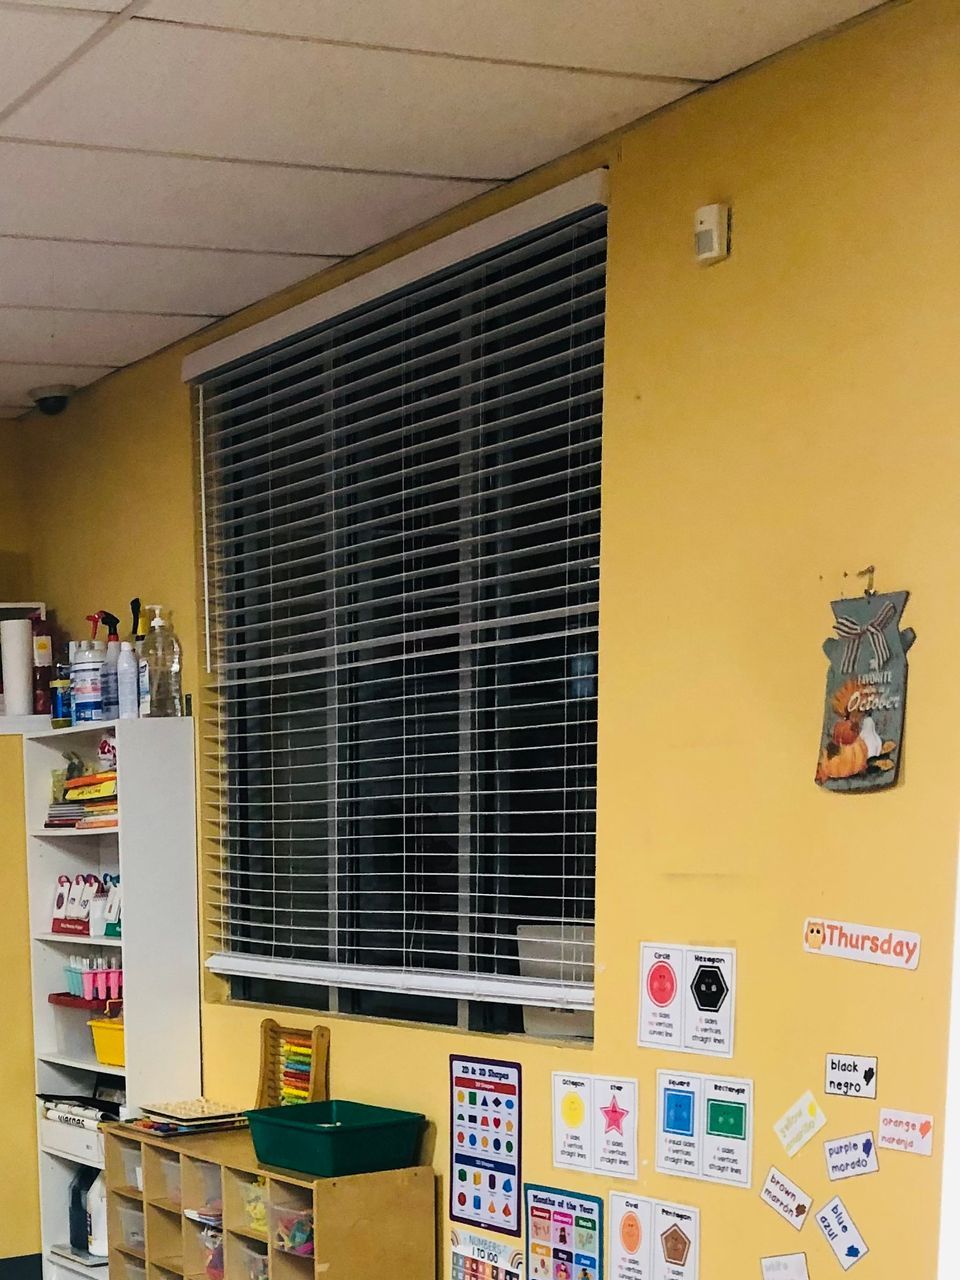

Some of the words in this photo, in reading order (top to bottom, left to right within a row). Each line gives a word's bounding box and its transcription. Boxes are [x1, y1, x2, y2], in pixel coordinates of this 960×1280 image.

[848, 691, 900, 712] October
[826, 924, 918, 964] Thursday
[654, 952, 671, 960] Circle
[694, 954, 726, 964] Hexagon
[831, 1059, 858, 1073] black
[488, 1069, 510, 1080] Shapes
[562, 1079, 586, 1088] Octagon
[668, 1079, 690, 1088] Square
[714, 1084, 746, 1095] Rectangle
[829, 1080, 862, 1096] negro
[882, 1118, 917, 1132] orange
[828, 1142, 859, 1158] purple
[881, 1135, 914, 1149] naranja
[831, 1158, 868, 1174] morado
[770, 1174, 797, 1202] brown
[532, 1194, 556, 1206] Months
[558, 1200, 564, 1208] of
[566, 1202, 576, 1211] the
[579, 1204, 594, 1214] Year
[624, 1201, 638, 1210] Oval
[764, 1188, 794, 1218] marrón
[661, 1208, 692, 1222] Pentagon
[831, 1204, 848, 1234] blue
[820, 1216, 838, 1241] azul
[468, 1234, 502, 1254] NUMBERS
[477, 1248, 486, 1259] TO
[487, 1252, 498, 1264] 100
